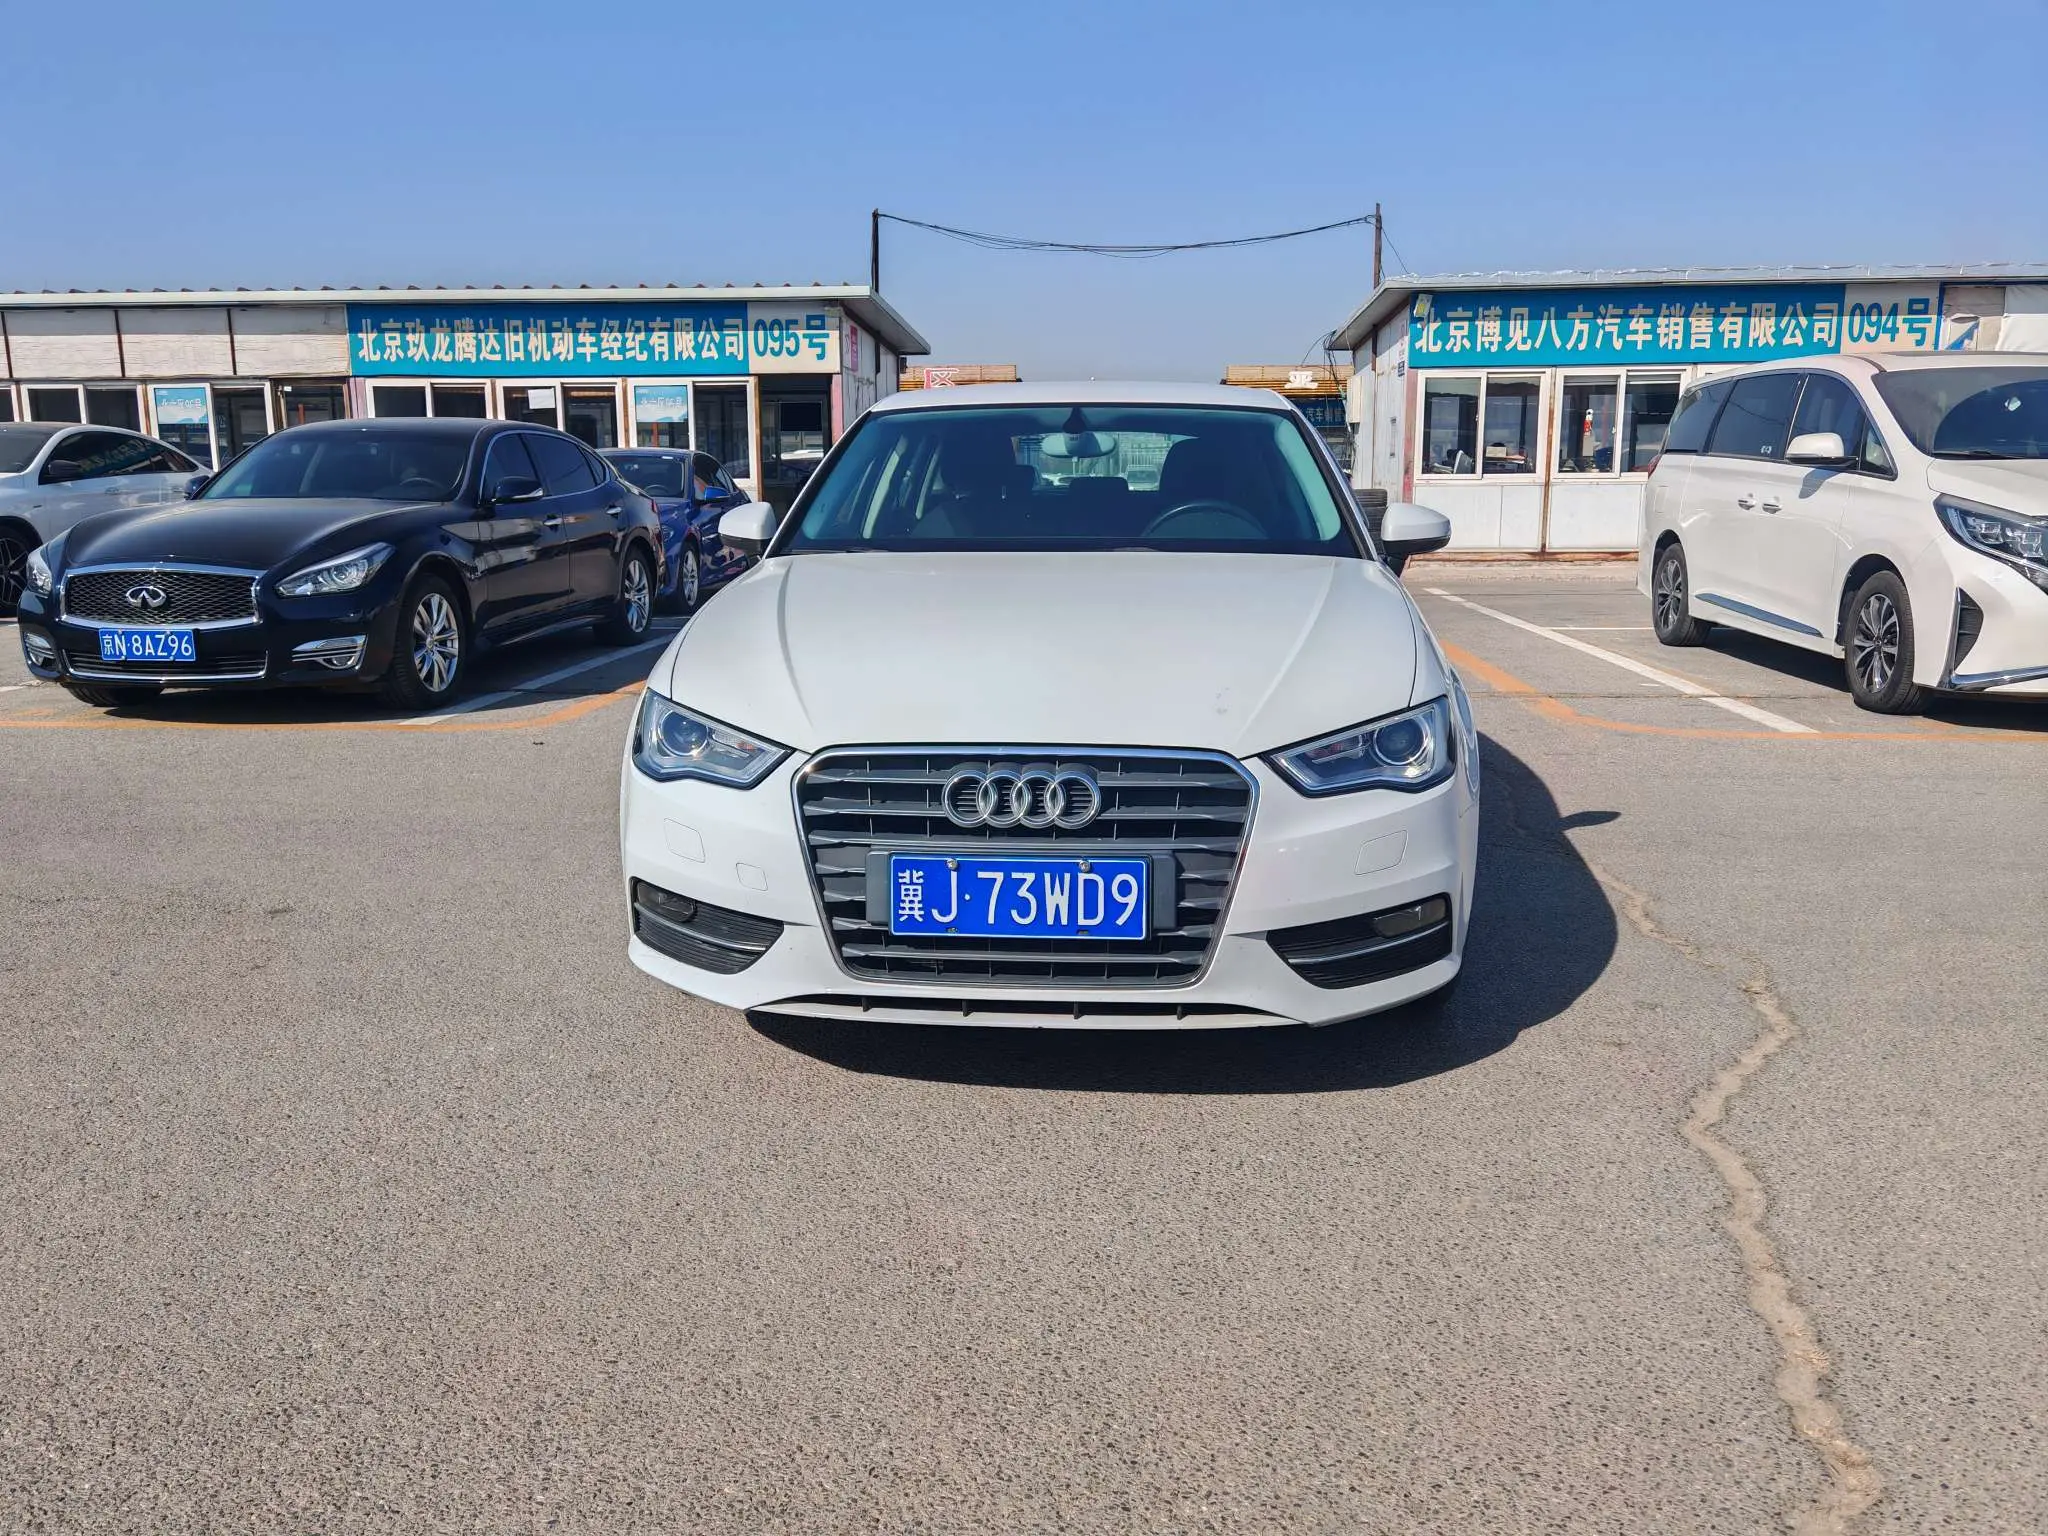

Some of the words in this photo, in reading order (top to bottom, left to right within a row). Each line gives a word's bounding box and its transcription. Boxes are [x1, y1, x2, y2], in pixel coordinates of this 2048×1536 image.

[358, 317, 744, 362] 北京玖龙腾达旧机动车经纪有限公司
[753, 314, 830, 360] 095号
[1415, 302, 1839, 353] 北京博见八方汽车销售有限公司
[1848, 298, 1933, 347] 094号
[898, 868, 1139, 927] 冀J·73WD9
